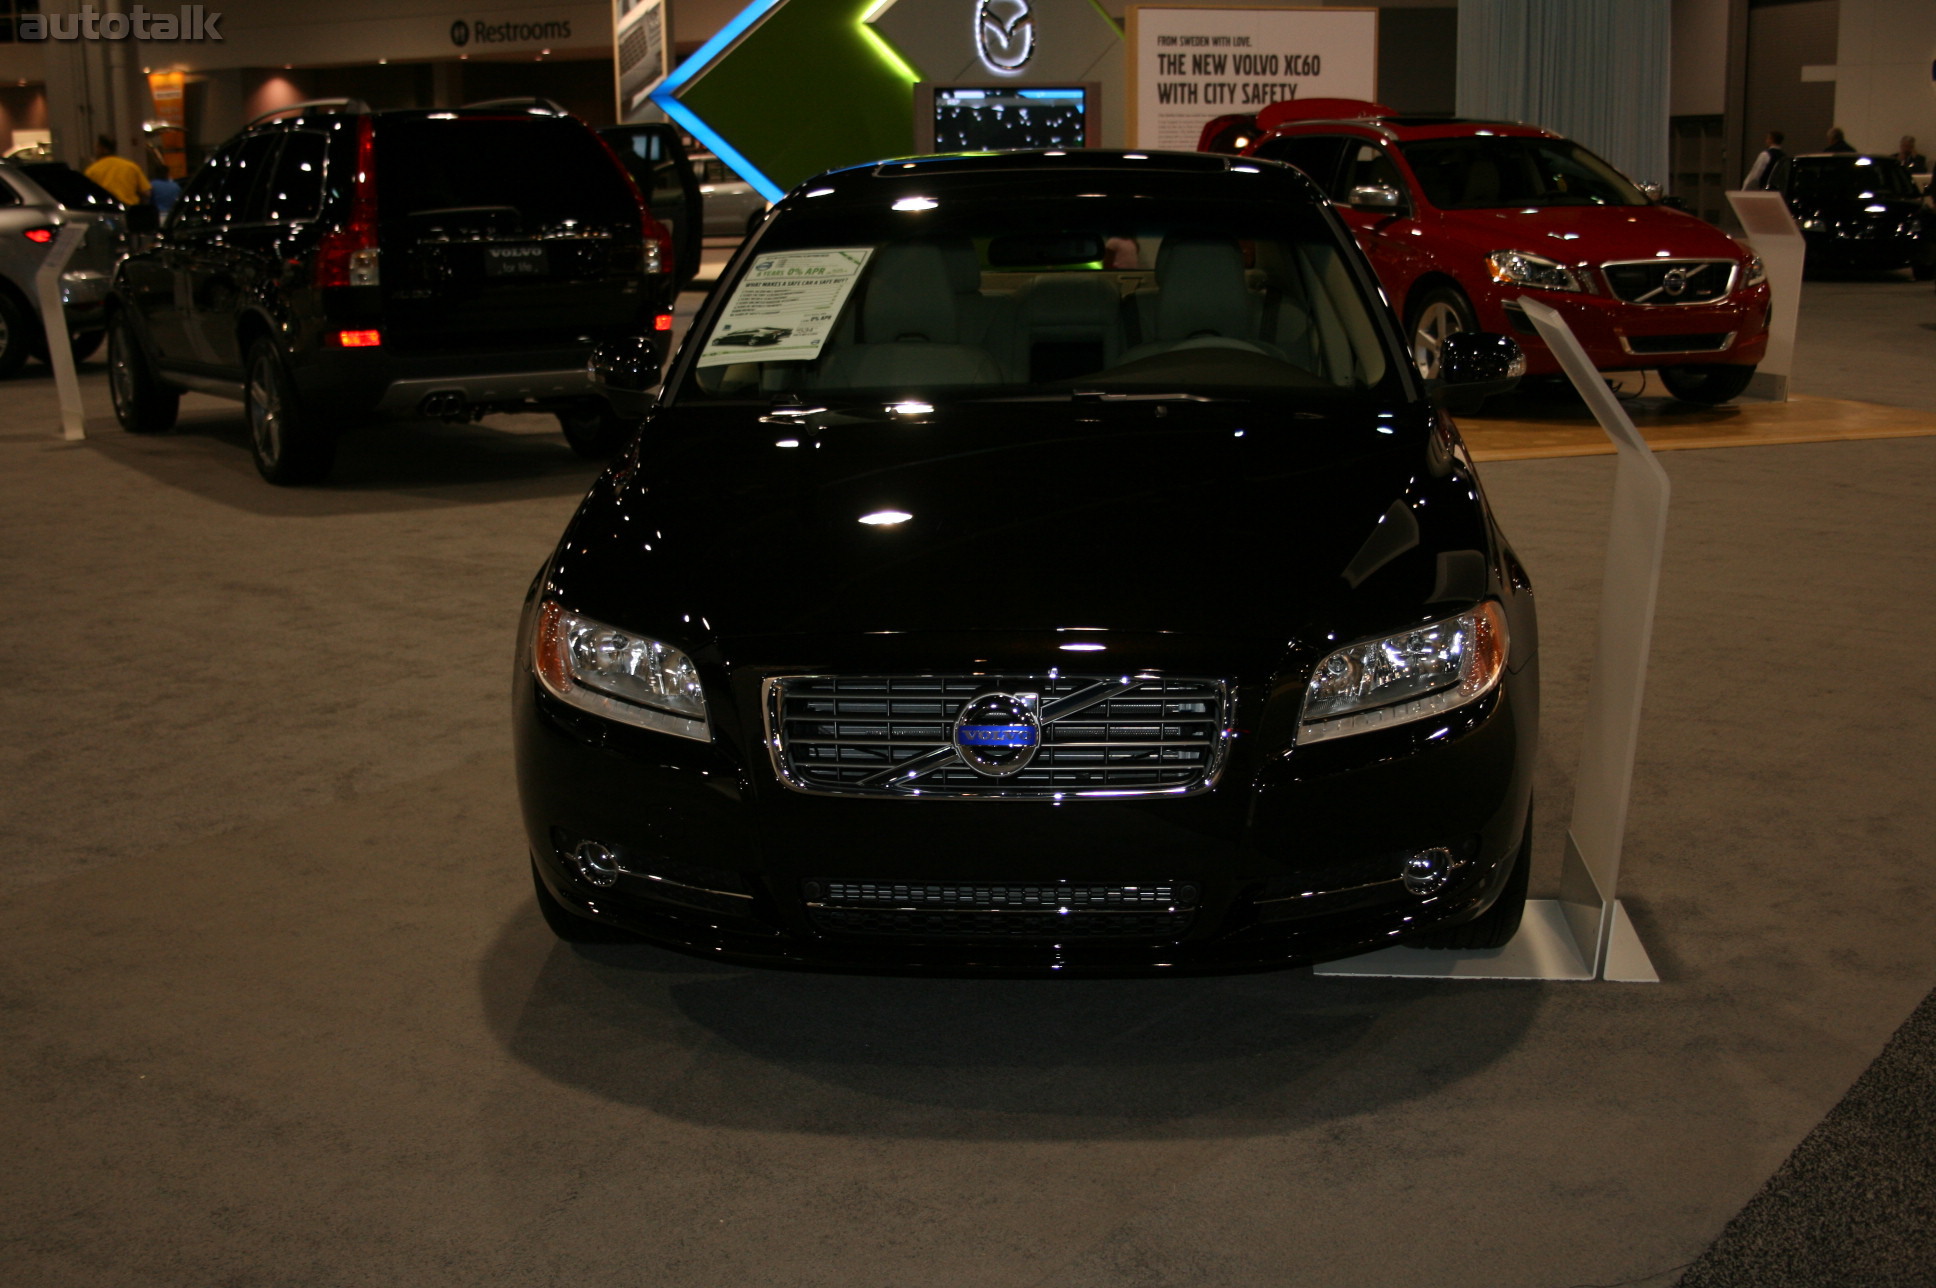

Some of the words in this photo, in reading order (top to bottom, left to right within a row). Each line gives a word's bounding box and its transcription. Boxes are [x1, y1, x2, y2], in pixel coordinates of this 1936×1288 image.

[474, 19, 571, 44] Restrooms
[1157, 36, 1177, 47] FROM
[1179, 36, 1210, 47] SWEDEN
[1211, 36, 1231, 47] WITH
[1232, 36, 1252, 47] LOVE.
[1158, 54, 1186, 76] THE
[1192, 54, 1227, 76] NEW
[1232, 54, 1279, 76] VOLVO
[1284, 54, 1321, 76] XC60
[1157, 82, 1198, 104] WITH
[1204, 82, 1236, 104] CITY
[1241, 82, 1298, 104] SAFETY
[488, 247, 542, 258] VOLVO
[787, 268, 803, 276] 0%
[804, 267, 826, 276] APR
[962, 730, 1031, 741] VOLVO
